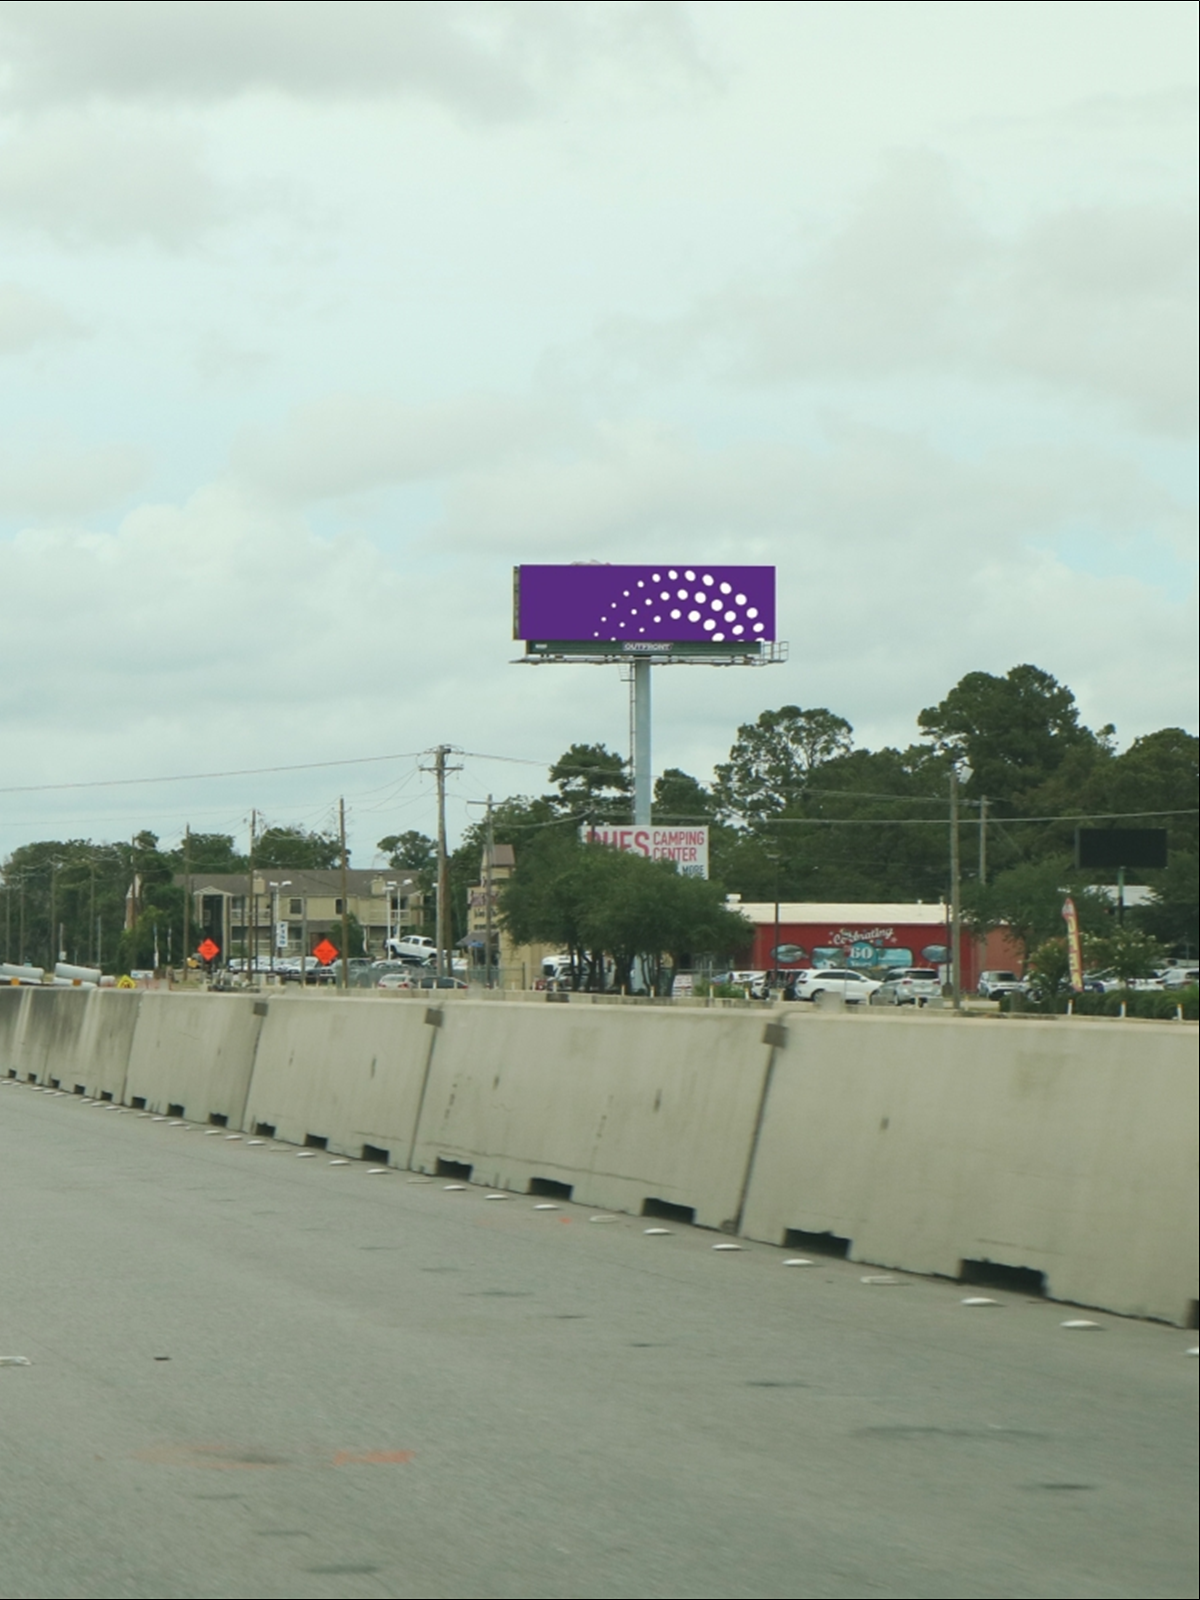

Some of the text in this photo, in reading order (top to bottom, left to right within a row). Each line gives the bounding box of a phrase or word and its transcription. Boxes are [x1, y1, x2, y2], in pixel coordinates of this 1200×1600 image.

[624, 642, 672, 651] OUTFRONT
[653, 831, 705, 845] CAMPING
[653, 847, 697, 861] CENTER
[850, 947, 873, 959] 60
